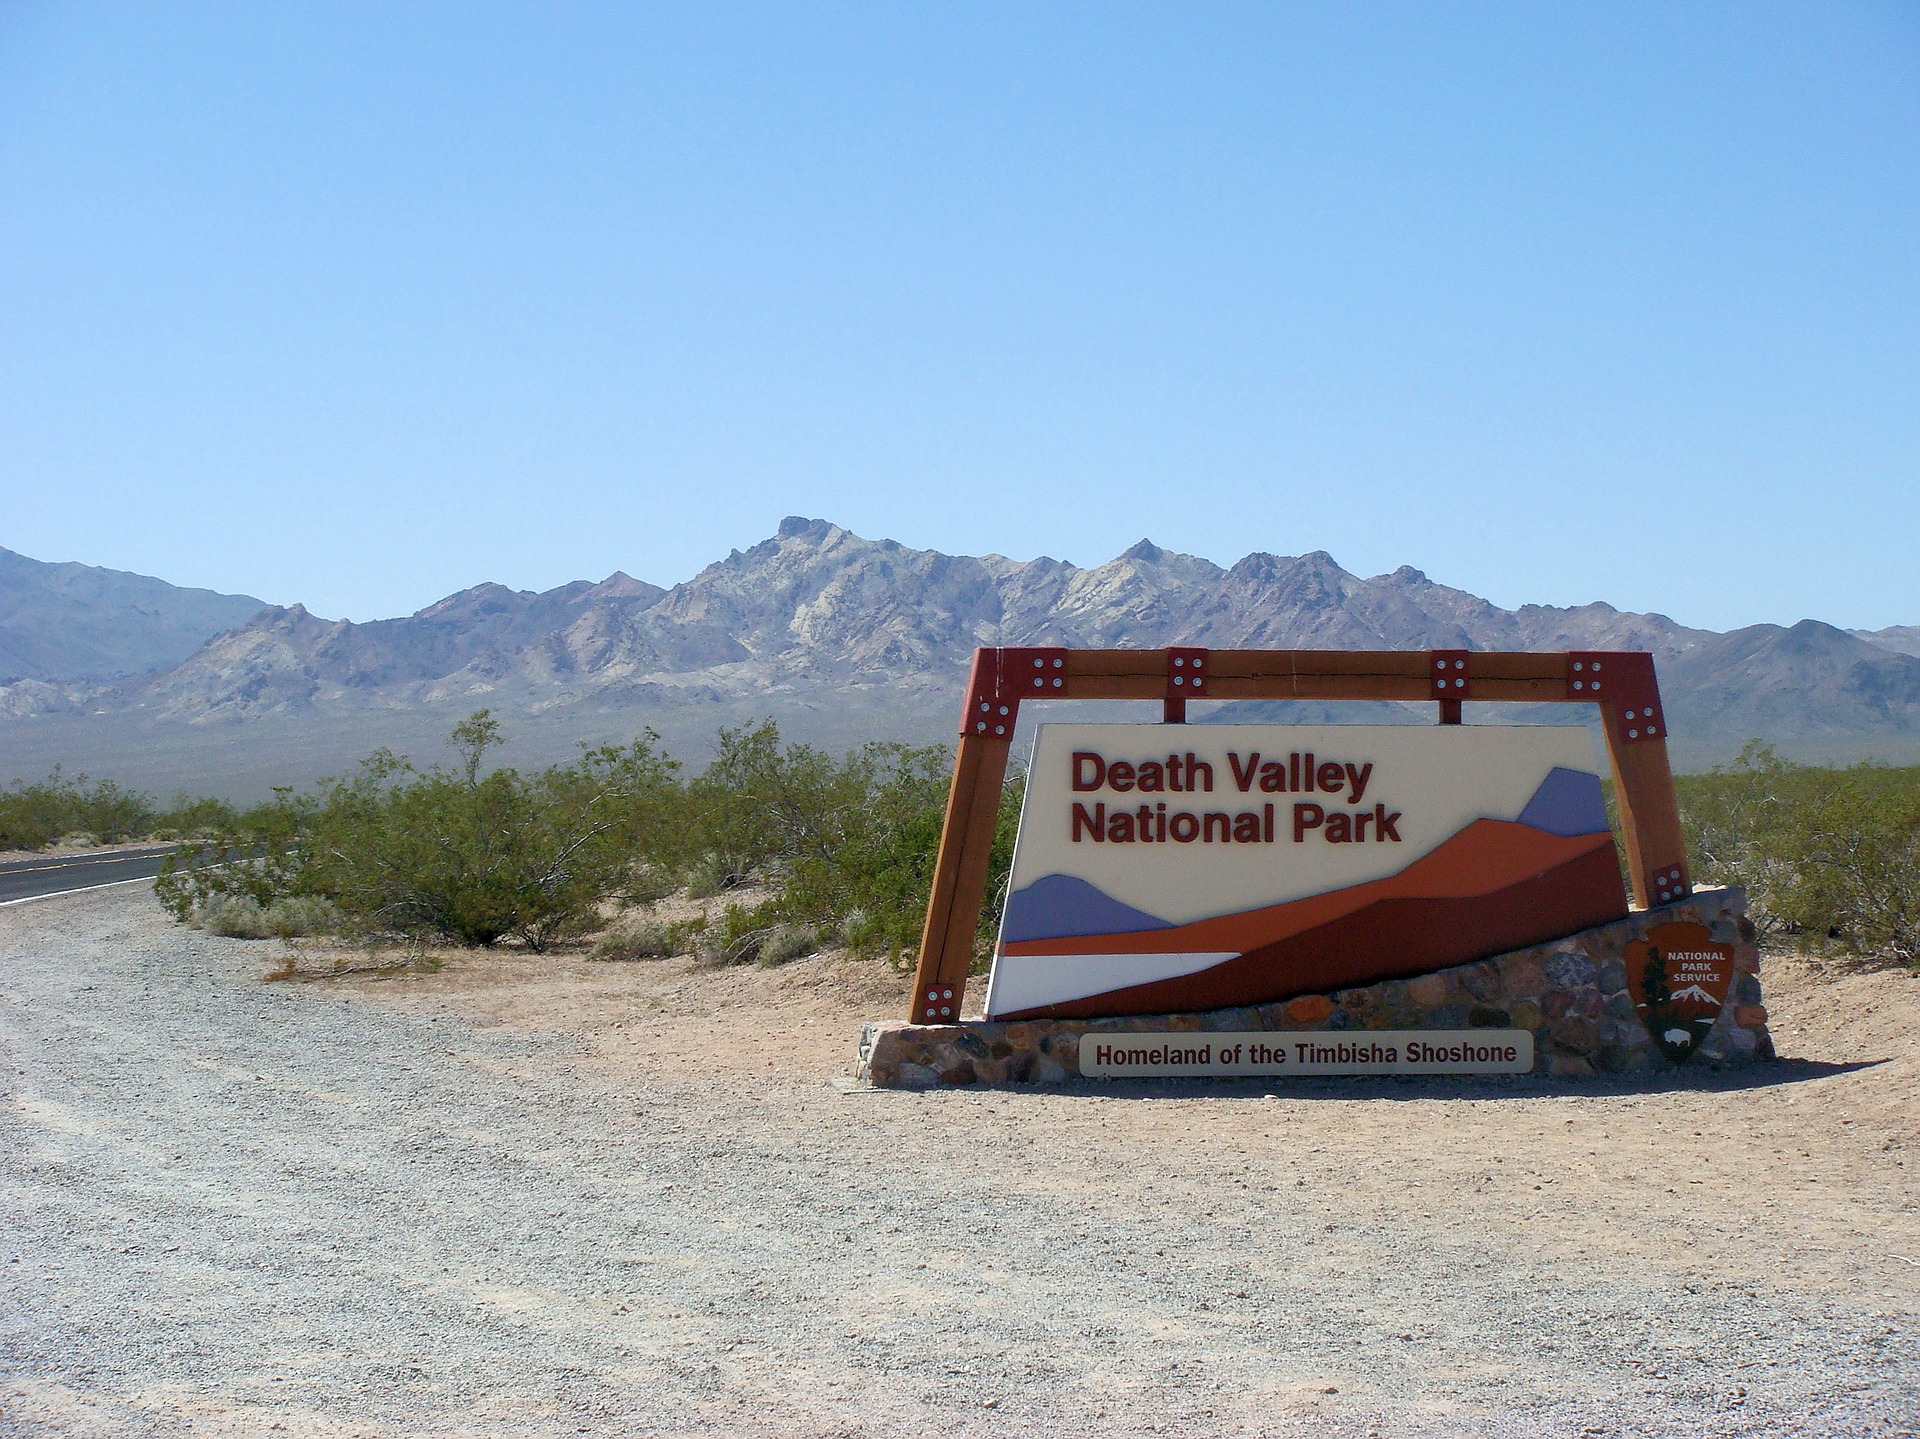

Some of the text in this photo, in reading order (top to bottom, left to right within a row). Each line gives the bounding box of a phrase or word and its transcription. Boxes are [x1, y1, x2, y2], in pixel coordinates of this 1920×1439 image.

[1072, 752, 1373, 804] Death Valley
[1072, 803, 1402, 843] National Park
[1668, 952, 1725, 961] NATIONAL
[1682, 963, 1711, 971] PARK
[1674, 973, 1720, 982] SERVICE
[1096, 1041, 1517, 1065] Homeland of the Timbisha Shoshone
